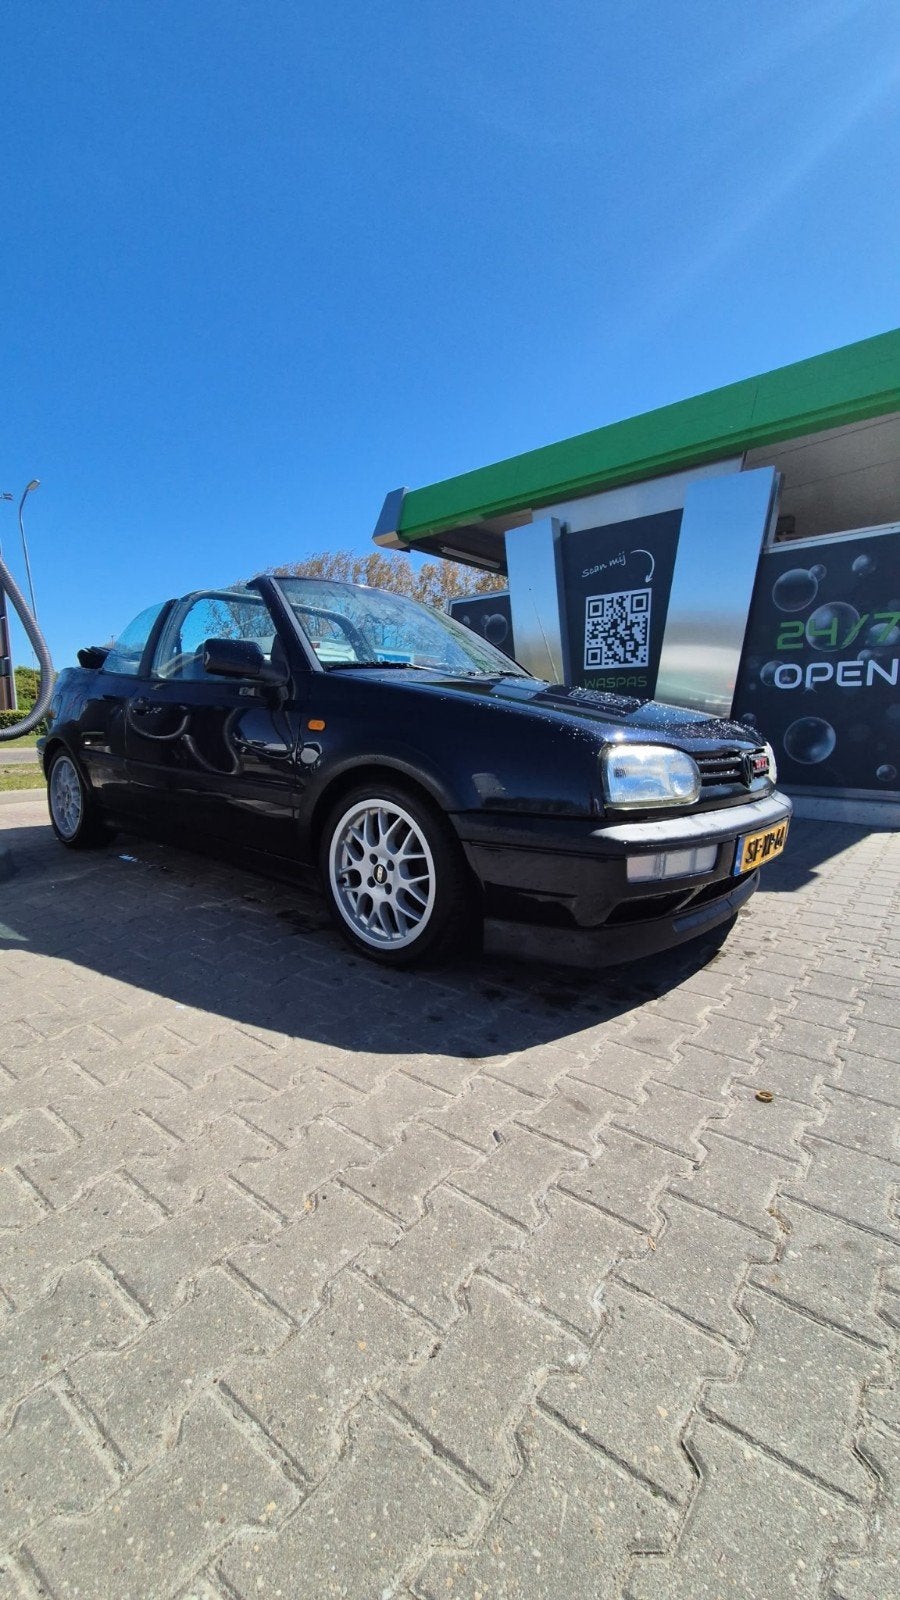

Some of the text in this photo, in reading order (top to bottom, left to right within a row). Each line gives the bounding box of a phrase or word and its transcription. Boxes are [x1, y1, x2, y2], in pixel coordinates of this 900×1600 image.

[609, 551, 626, 567] mij
[776, 611, 900, 650] 24/7
[584, 675, 648, 689] WASPAS
[774, 658, 899, 689] OPEN
